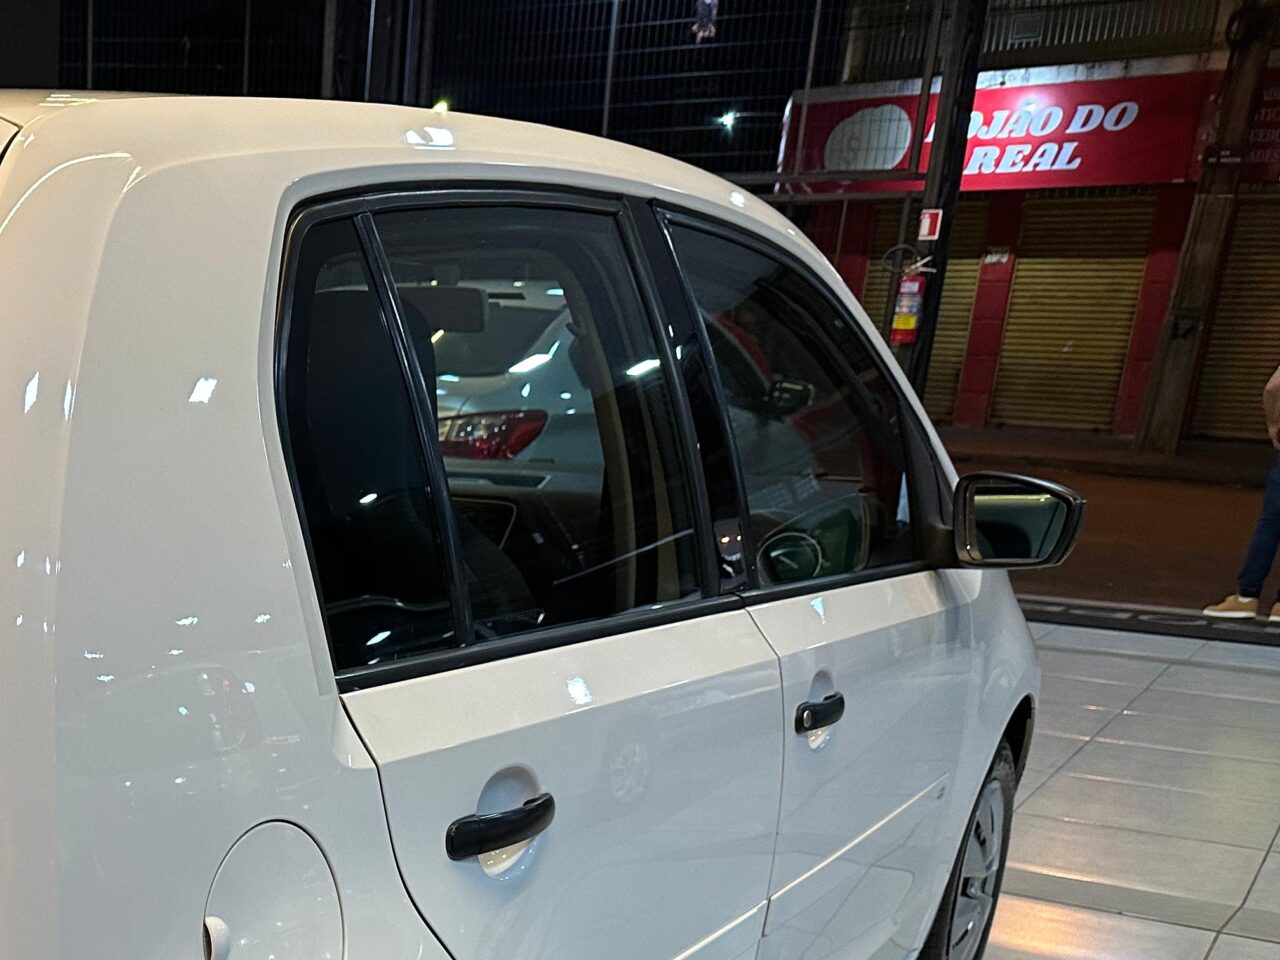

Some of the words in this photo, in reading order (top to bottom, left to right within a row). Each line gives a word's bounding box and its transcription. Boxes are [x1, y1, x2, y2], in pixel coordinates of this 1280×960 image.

[924, 99, 1064, 143] OJÃO
[1066, 101, 1139, 134] DO
[963, 141, 1083, 175] REAL
